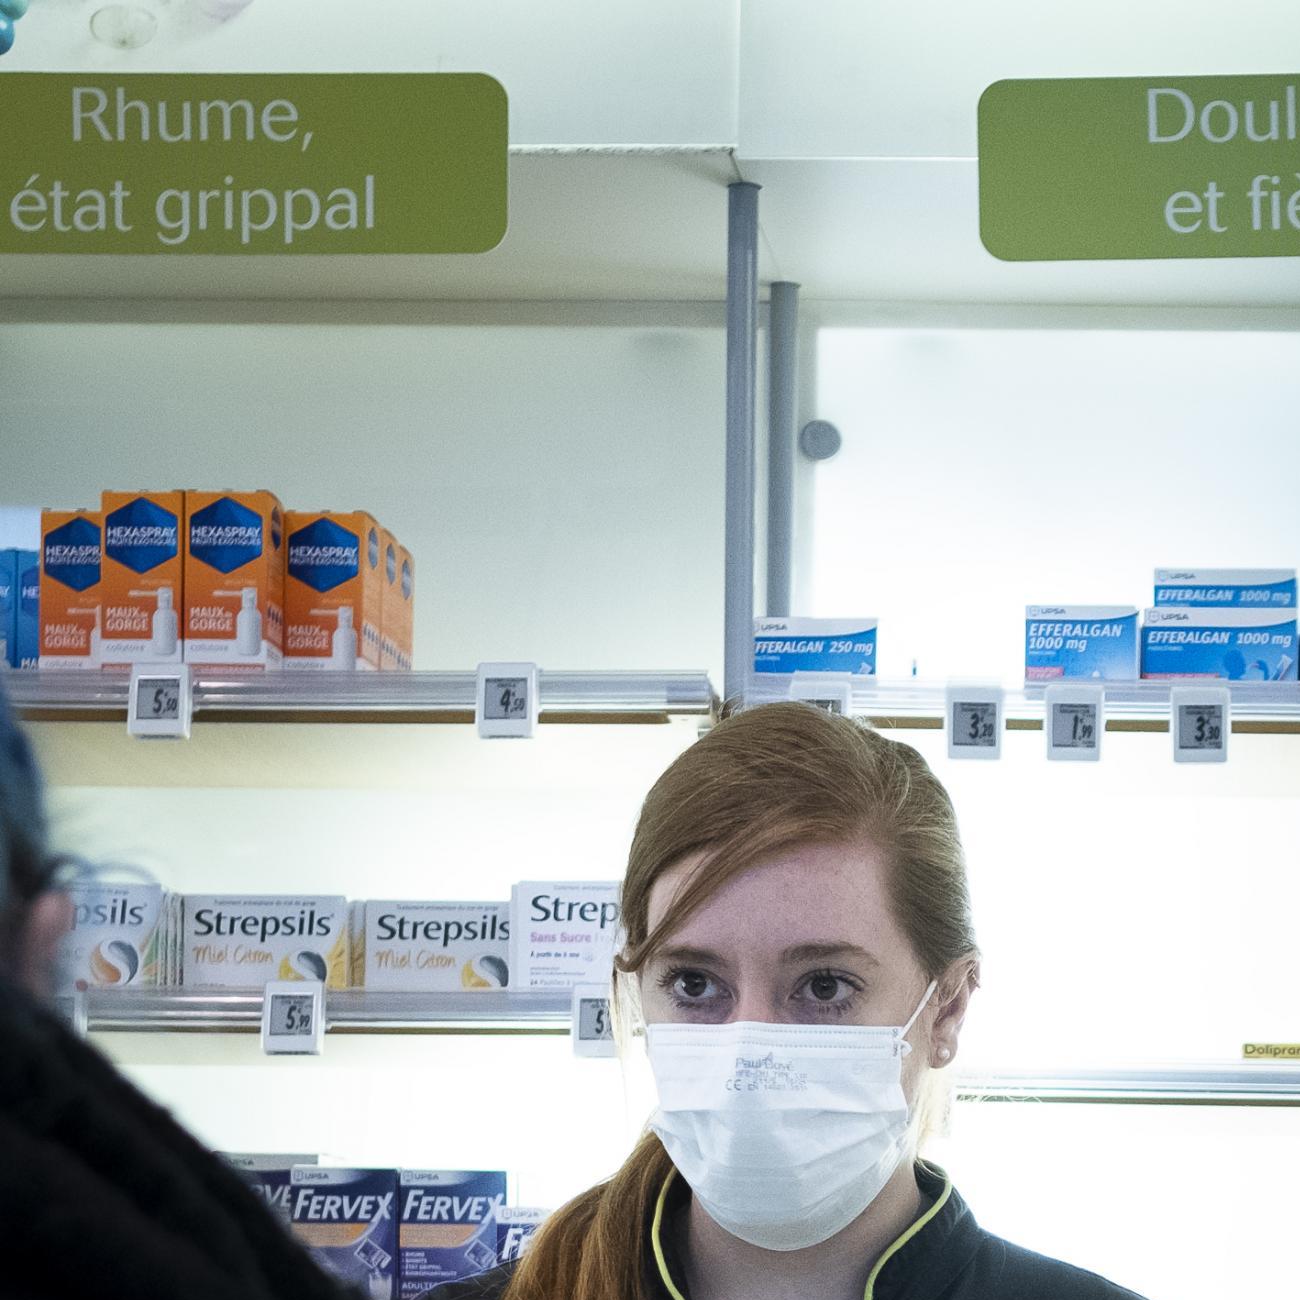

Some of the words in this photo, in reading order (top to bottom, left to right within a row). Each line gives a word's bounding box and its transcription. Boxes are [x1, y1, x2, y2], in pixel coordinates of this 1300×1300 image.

[71, 86, 315, 152] Rhume,
[8, 174, 131, 234] état
[154, 175, 376, 245] grippal
[1164, 180, 1228, 234] et
[107, 526, 176, 538] HEXASPRAY
[191, 526, 261, 538] HEXASPRAY
[46, 545, 101, 557] HEXASPR
[289, 546, 357, 558] HEXASPRAY
[1158, 589, 1233, 601] EFFERALGAN
[1240, 590, 1270, 601] 1000
[1272, 592, 1291, 604] mg
[106, 607, 140, 618] MAUX
[190, 607, 224, 618] MAUX
[45, 624, 77, 635] MAUX
[106, 619, 148, 631] GORGE
[190, 619, 232, 631] GORGE
[288, 626, 321, 636] MAUX
[1029, 623, 1122, 637] EFFERALGAN
[45, 635, 86, 648] GORGE
[288, 637, 329, 648] GORGE
[1029, 637, 1062, 649] 1000
[1066, 639, 1087, 652] mg
[1147, 631, 1229, 644] EFFERALGAN
[1237, 632, 1269, 644] 1000
[1272, 634, 1292, 647] mg
[755, 640, 823, 654] FFERALGAN
[829, 641, 852, 653] 250
[853, 643, 873, 656] mg
[75, 899, 144, 930] psils
[531, 894, 619, 928] Strep
[193, 909, 331, 943] Strepsils
[376, 914, 509, 947] Strepsils
[530, 932, 557, 943] Sans
[560, 932, 591, 943] Sucre
[191, 944, 229, 965] Miel
[234, 943, 273, 964] Citron
[375, 949, 410, 969] Miel
[416, 950, 456, 969] Citron
[293, 1188, 394, 1221] FERVEX
[402, 1189, 505, 1221] FERVEX
[402, 1282, 437, 1290] ADULTE
